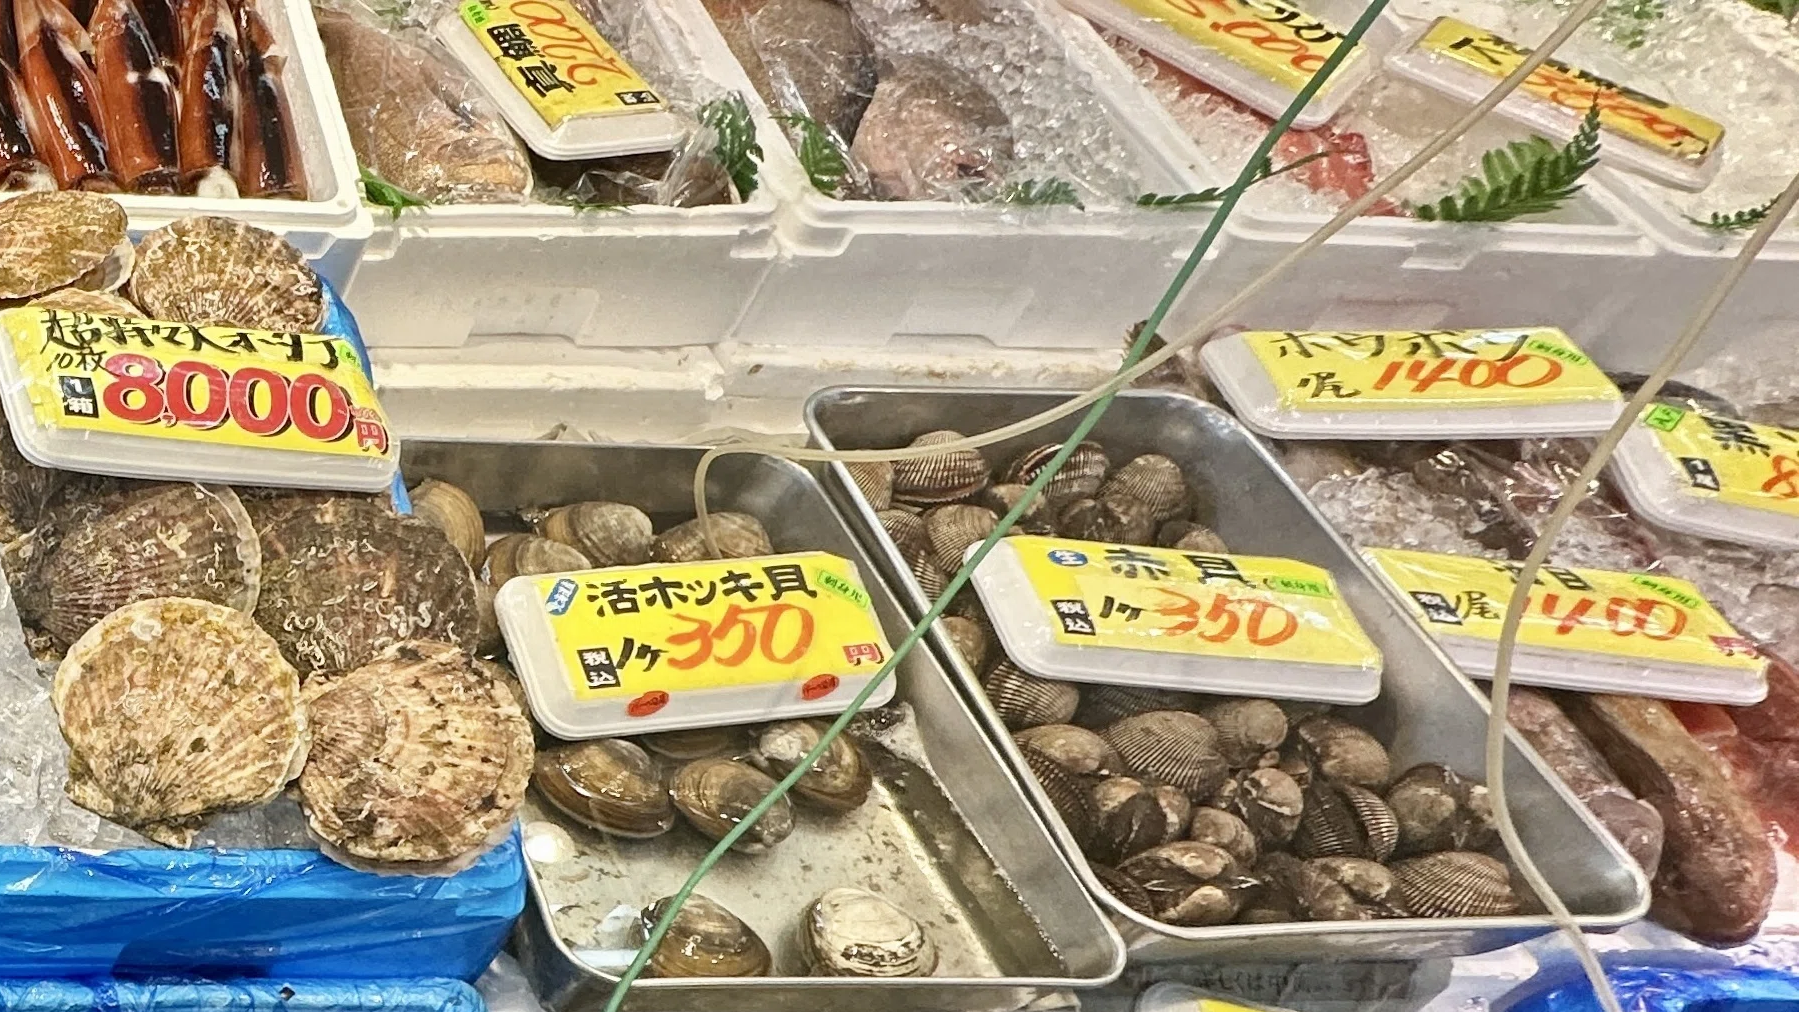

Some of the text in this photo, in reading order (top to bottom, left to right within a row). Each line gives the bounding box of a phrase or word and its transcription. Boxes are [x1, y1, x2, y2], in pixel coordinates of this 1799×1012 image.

[587, 564, 819, 617] 活ホッキ貝
[1151, 587, 1298, 646] 350
[582, 651, 617, 686] 税込
[667, 603, 814, 670] 350
